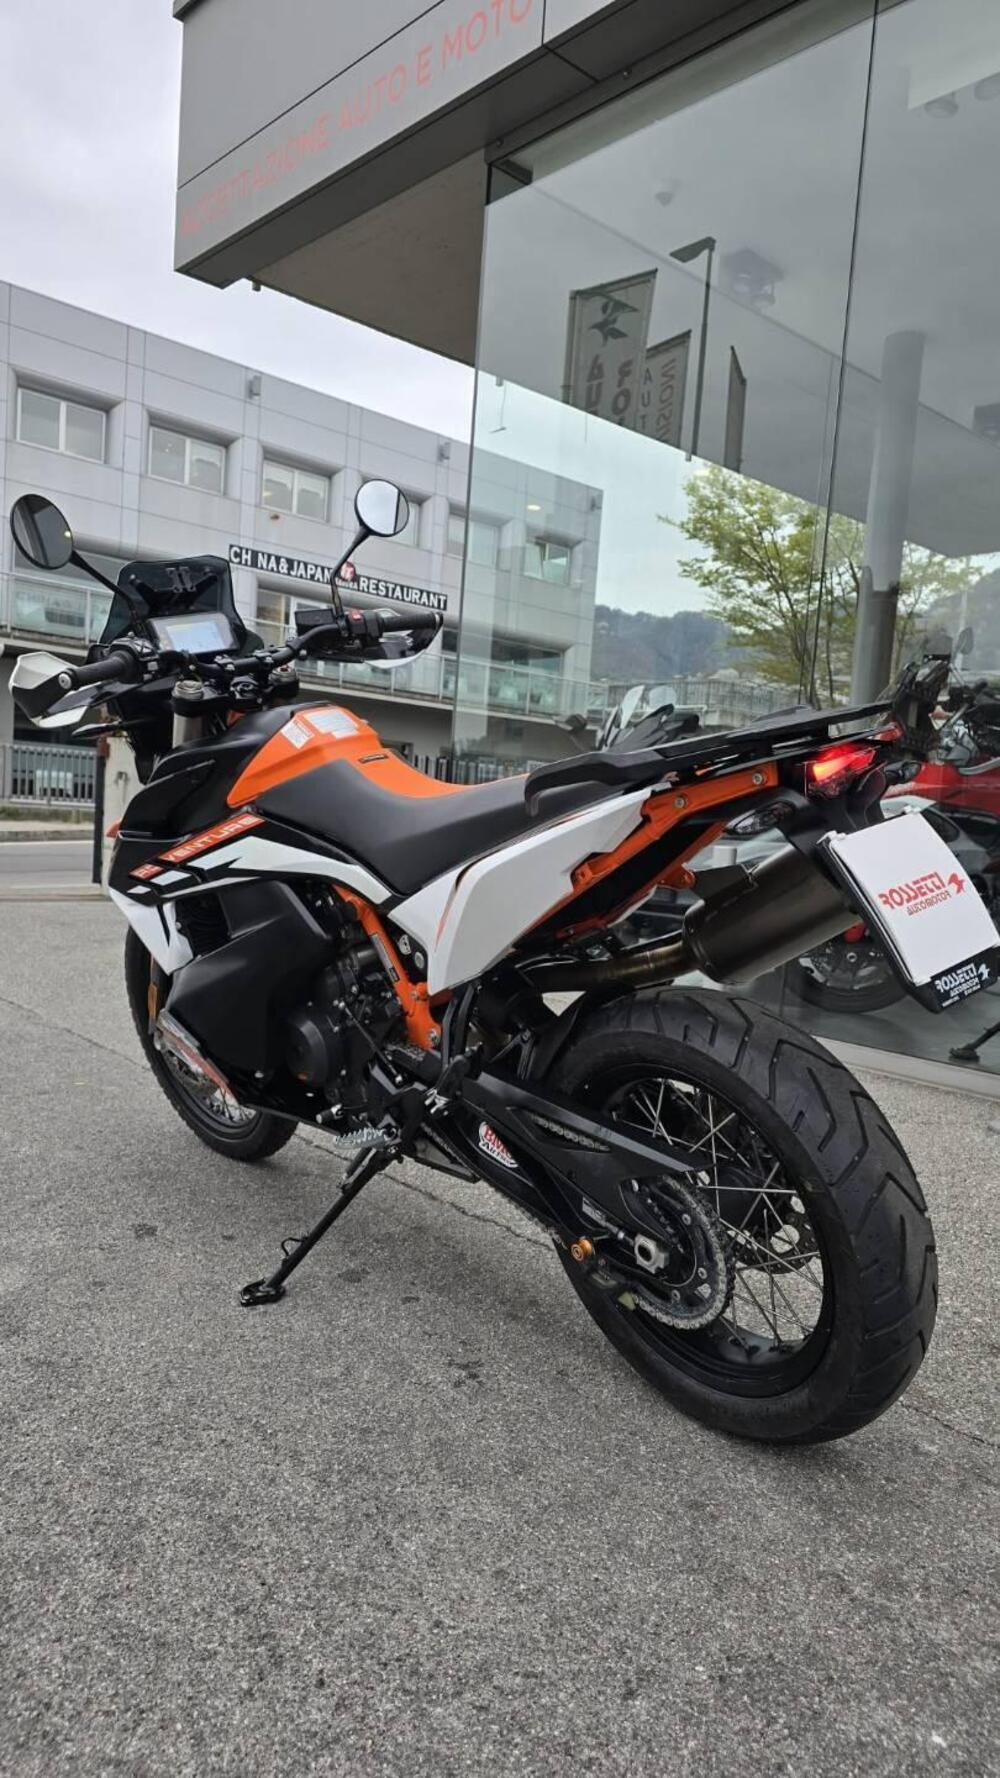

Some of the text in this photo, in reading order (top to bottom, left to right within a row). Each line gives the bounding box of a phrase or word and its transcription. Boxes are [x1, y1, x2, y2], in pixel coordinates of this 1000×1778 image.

[337, 63, 407, 129] AUTO
[416, 45, 433, 86] E
[441, 0, 533, 70] MOTO
[360, 577, 447, 611] RESTAURANT
[878, 872, 946, 910] ROSSETTI
